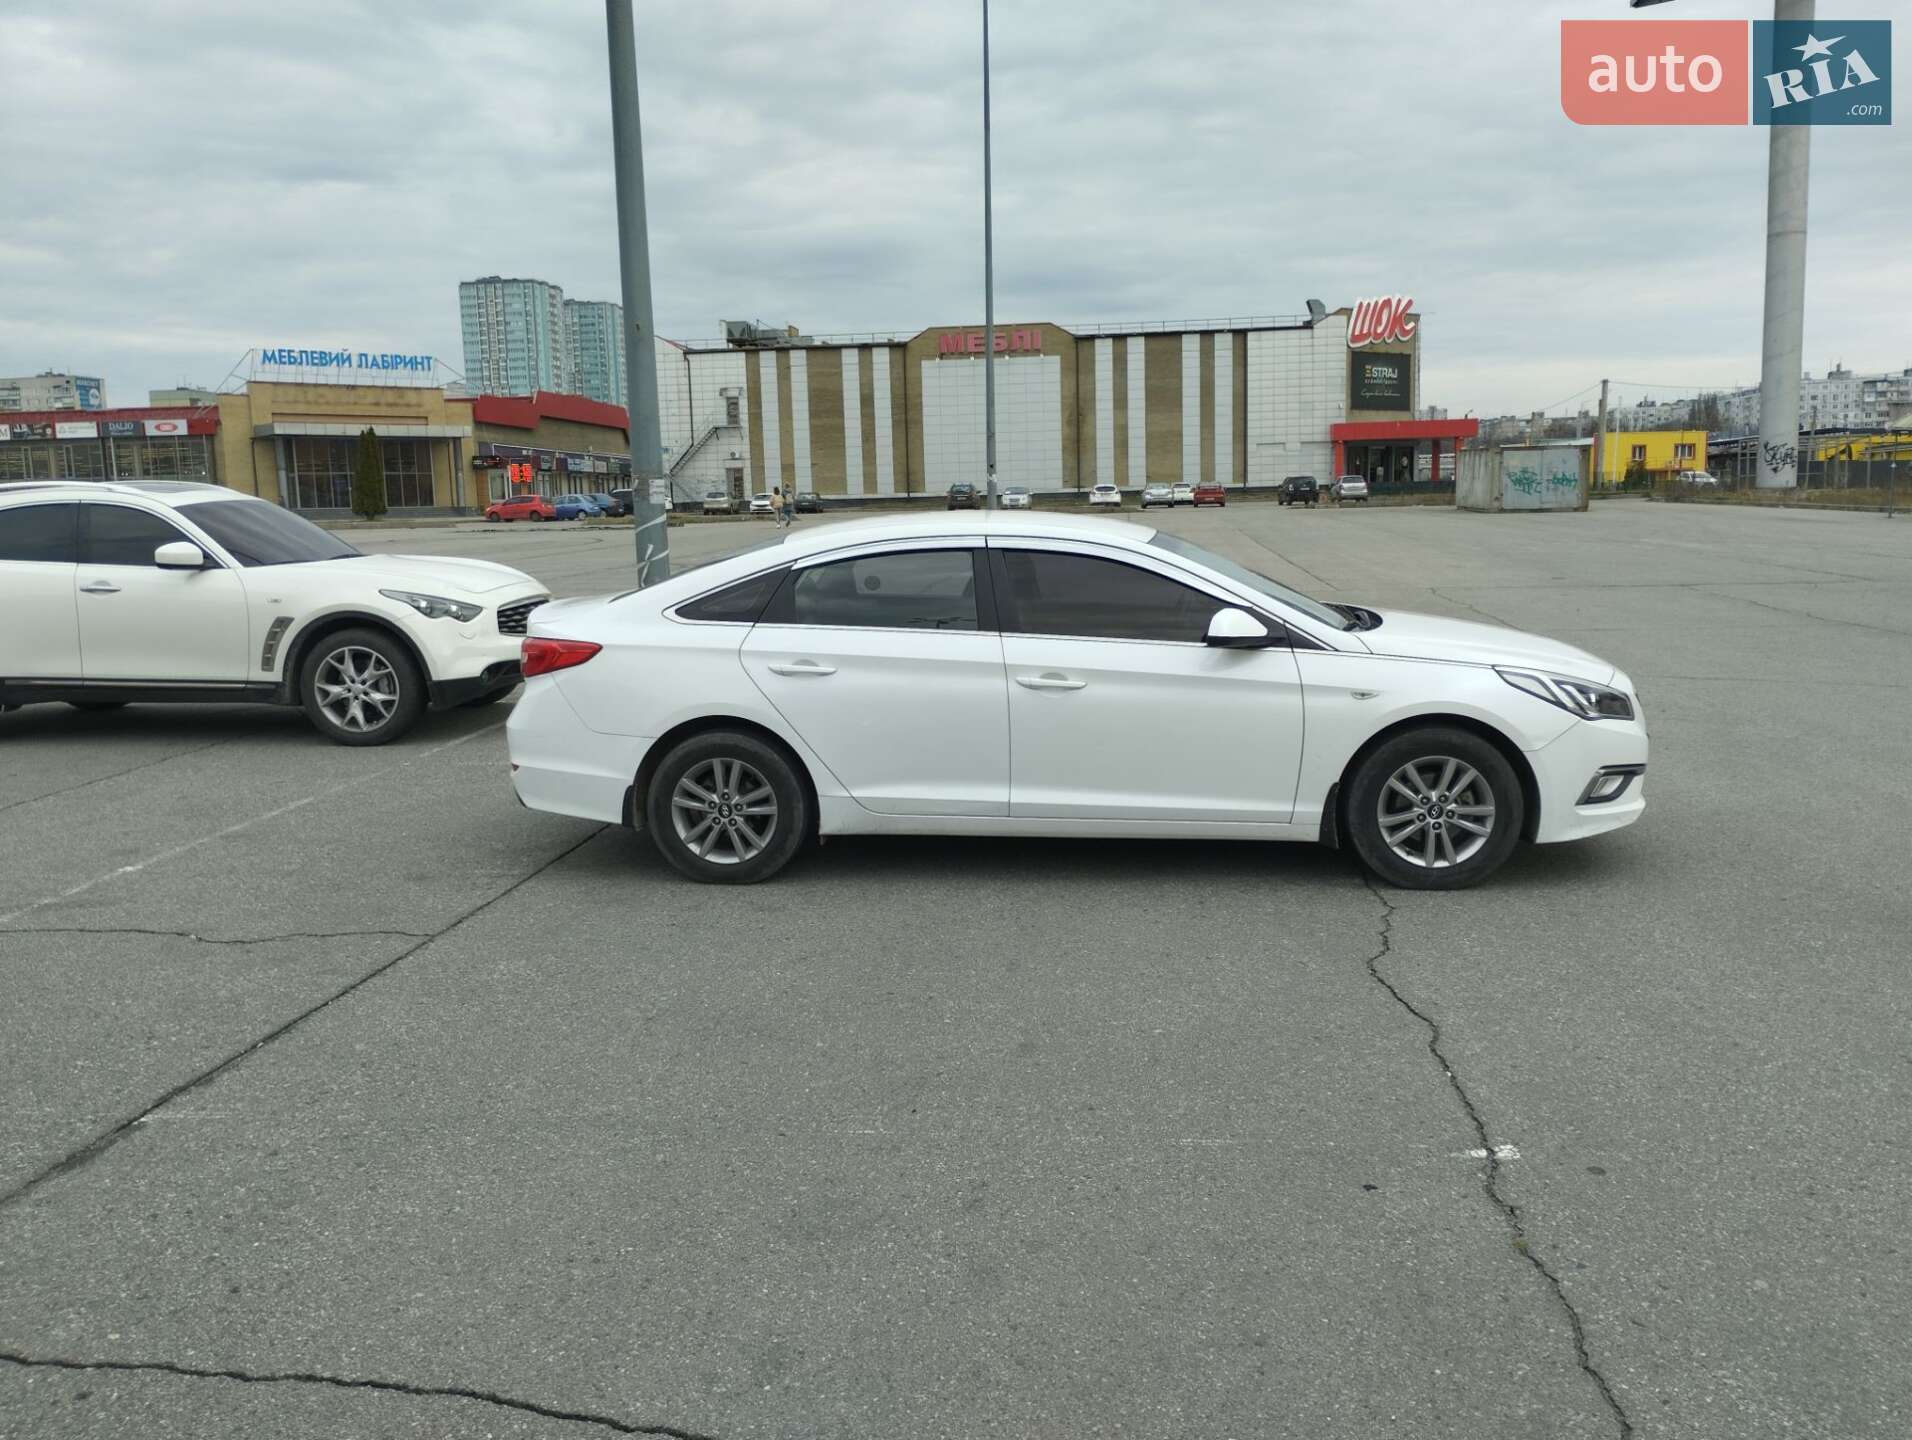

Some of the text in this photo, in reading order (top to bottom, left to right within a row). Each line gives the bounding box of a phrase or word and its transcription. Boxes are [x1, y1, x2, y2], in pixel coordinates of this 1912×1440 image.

[1348, 295, 1415, 347] ШОК
[938, 329, 1042, 353] МЕБЛІ
[262, 347, 433, 371] МЕБЛЕВИЙ ЛАБІРИНТ
